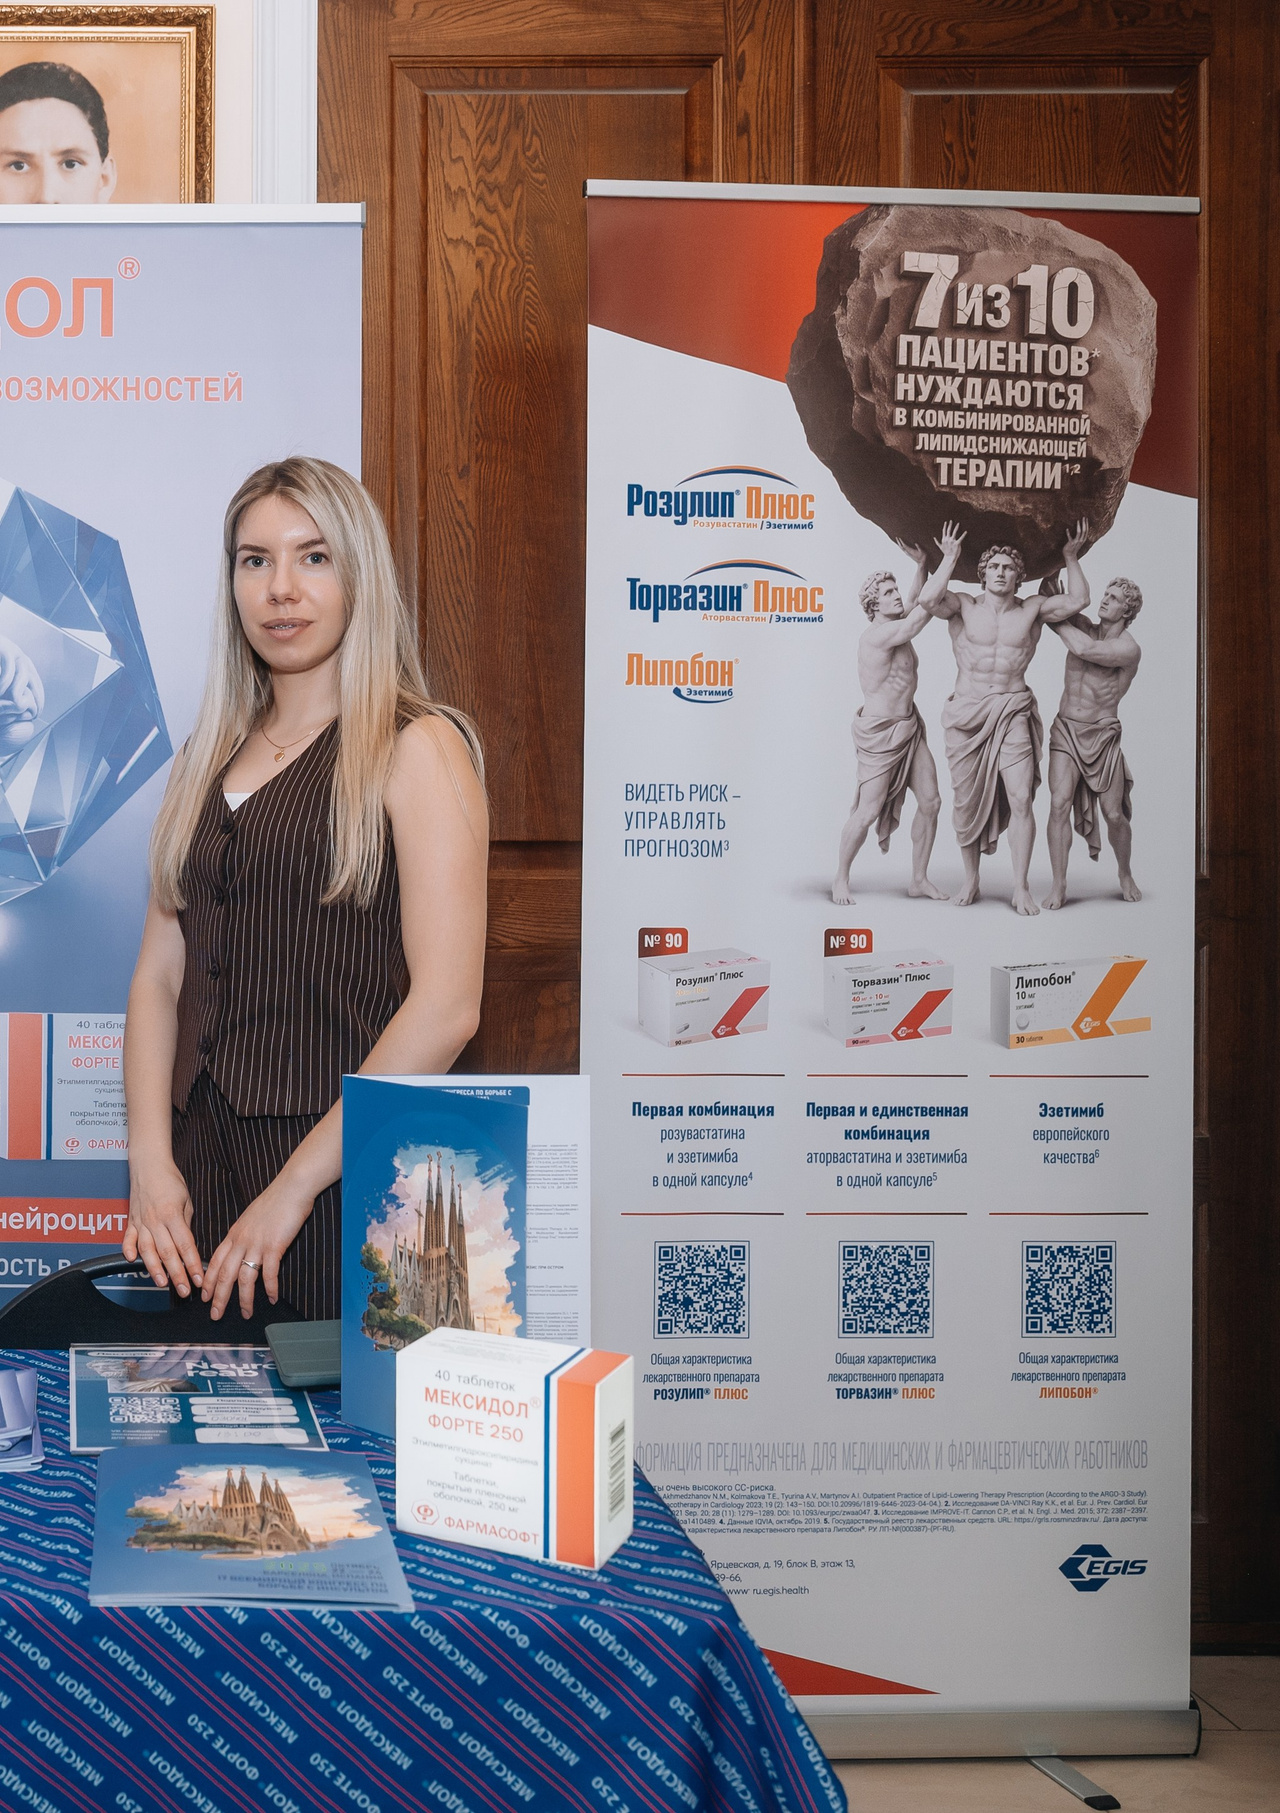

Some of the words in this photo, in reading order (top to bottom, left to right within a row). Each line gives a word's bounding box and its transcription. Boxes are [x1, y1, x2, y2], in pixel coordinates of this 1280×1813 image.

[900, 252, 959, 329] 7
[956, 282, 1011, 329] ИЗ
[1013, 264, 1095, 339] 10
[896, 373, 1084, 411] НУЖДАЮТСЯ
[912, 409, 1091, 435] КОМБИНИРОВАННОЙ
[916, 432, 1087, 459] ЛИПИДСНИЖАЮЩЕЙ
[746, 486, 814, 520] Плюс
[753, 580, 823, 613] Плюс
[702, 613, 766, 623] Аторвастатин
[624, 783, 685, 805] ВИДЕТЬ
[688, 783, 729, 802] РИСК
[624, 811, 726, 831] УПРАВЛЯТЬ
[664, 932, 683, 949] 90
[720, 970, 744, 981] Плюс
[632, 1102, 684, 1119] Первая
[688, 1102, 775, 1119] комбинация
[872, 1103, 969, 1120] единственная
[1039, 1103, 1104, 1119] Эзетимиб
[660, 1125, 745, 1141] розувастатина
[844, 1126, 930, 1142] комбинация
[1032, 1128, 1109, 1144] европейского
[806, 1150, 891, 1166] аторвастатина
[650, 1353, 679, 1367] Общая
[682, 1353, 752, 1367] характеристика
[435, 1370, 450, 1381] 40
[457, 1374, 515, 1391] таблеток
[827, 1371, 898, 1384] лекарственного
[901, 1371, 944, 1384] препарата
[714, 1386, 749, 1400] ПЛЮС
[428, 1414, 484, 1436] ФОРТЕ
[490, 1424, 523, 1442] 250
[707, 1441, 806, 1475] ПРЕДНАЗНАЧЕНА
[811, 1441, 836, 1475] ДЛЯ
[1074, 1440, 1148, 1470] РАБОТНИКОВ
[444, 1516, 539, 1544] ФАРМАСОФТ
[710, 1560, 761, 1570] Ярцевская,
[786, 1559, 807, 1569] блок
[820, 1560, 842, 1569] этаж
[1087, 1560, 1148, 1575] EGIS
[753, 1586, 809, 1596] ru.egis.health
[259, 1631, 289, 1659] 250
[284, 1656, 332, 1699] ФОРТЕ
[335, 1699, 413, 1770] МЕКСИДОЛ
